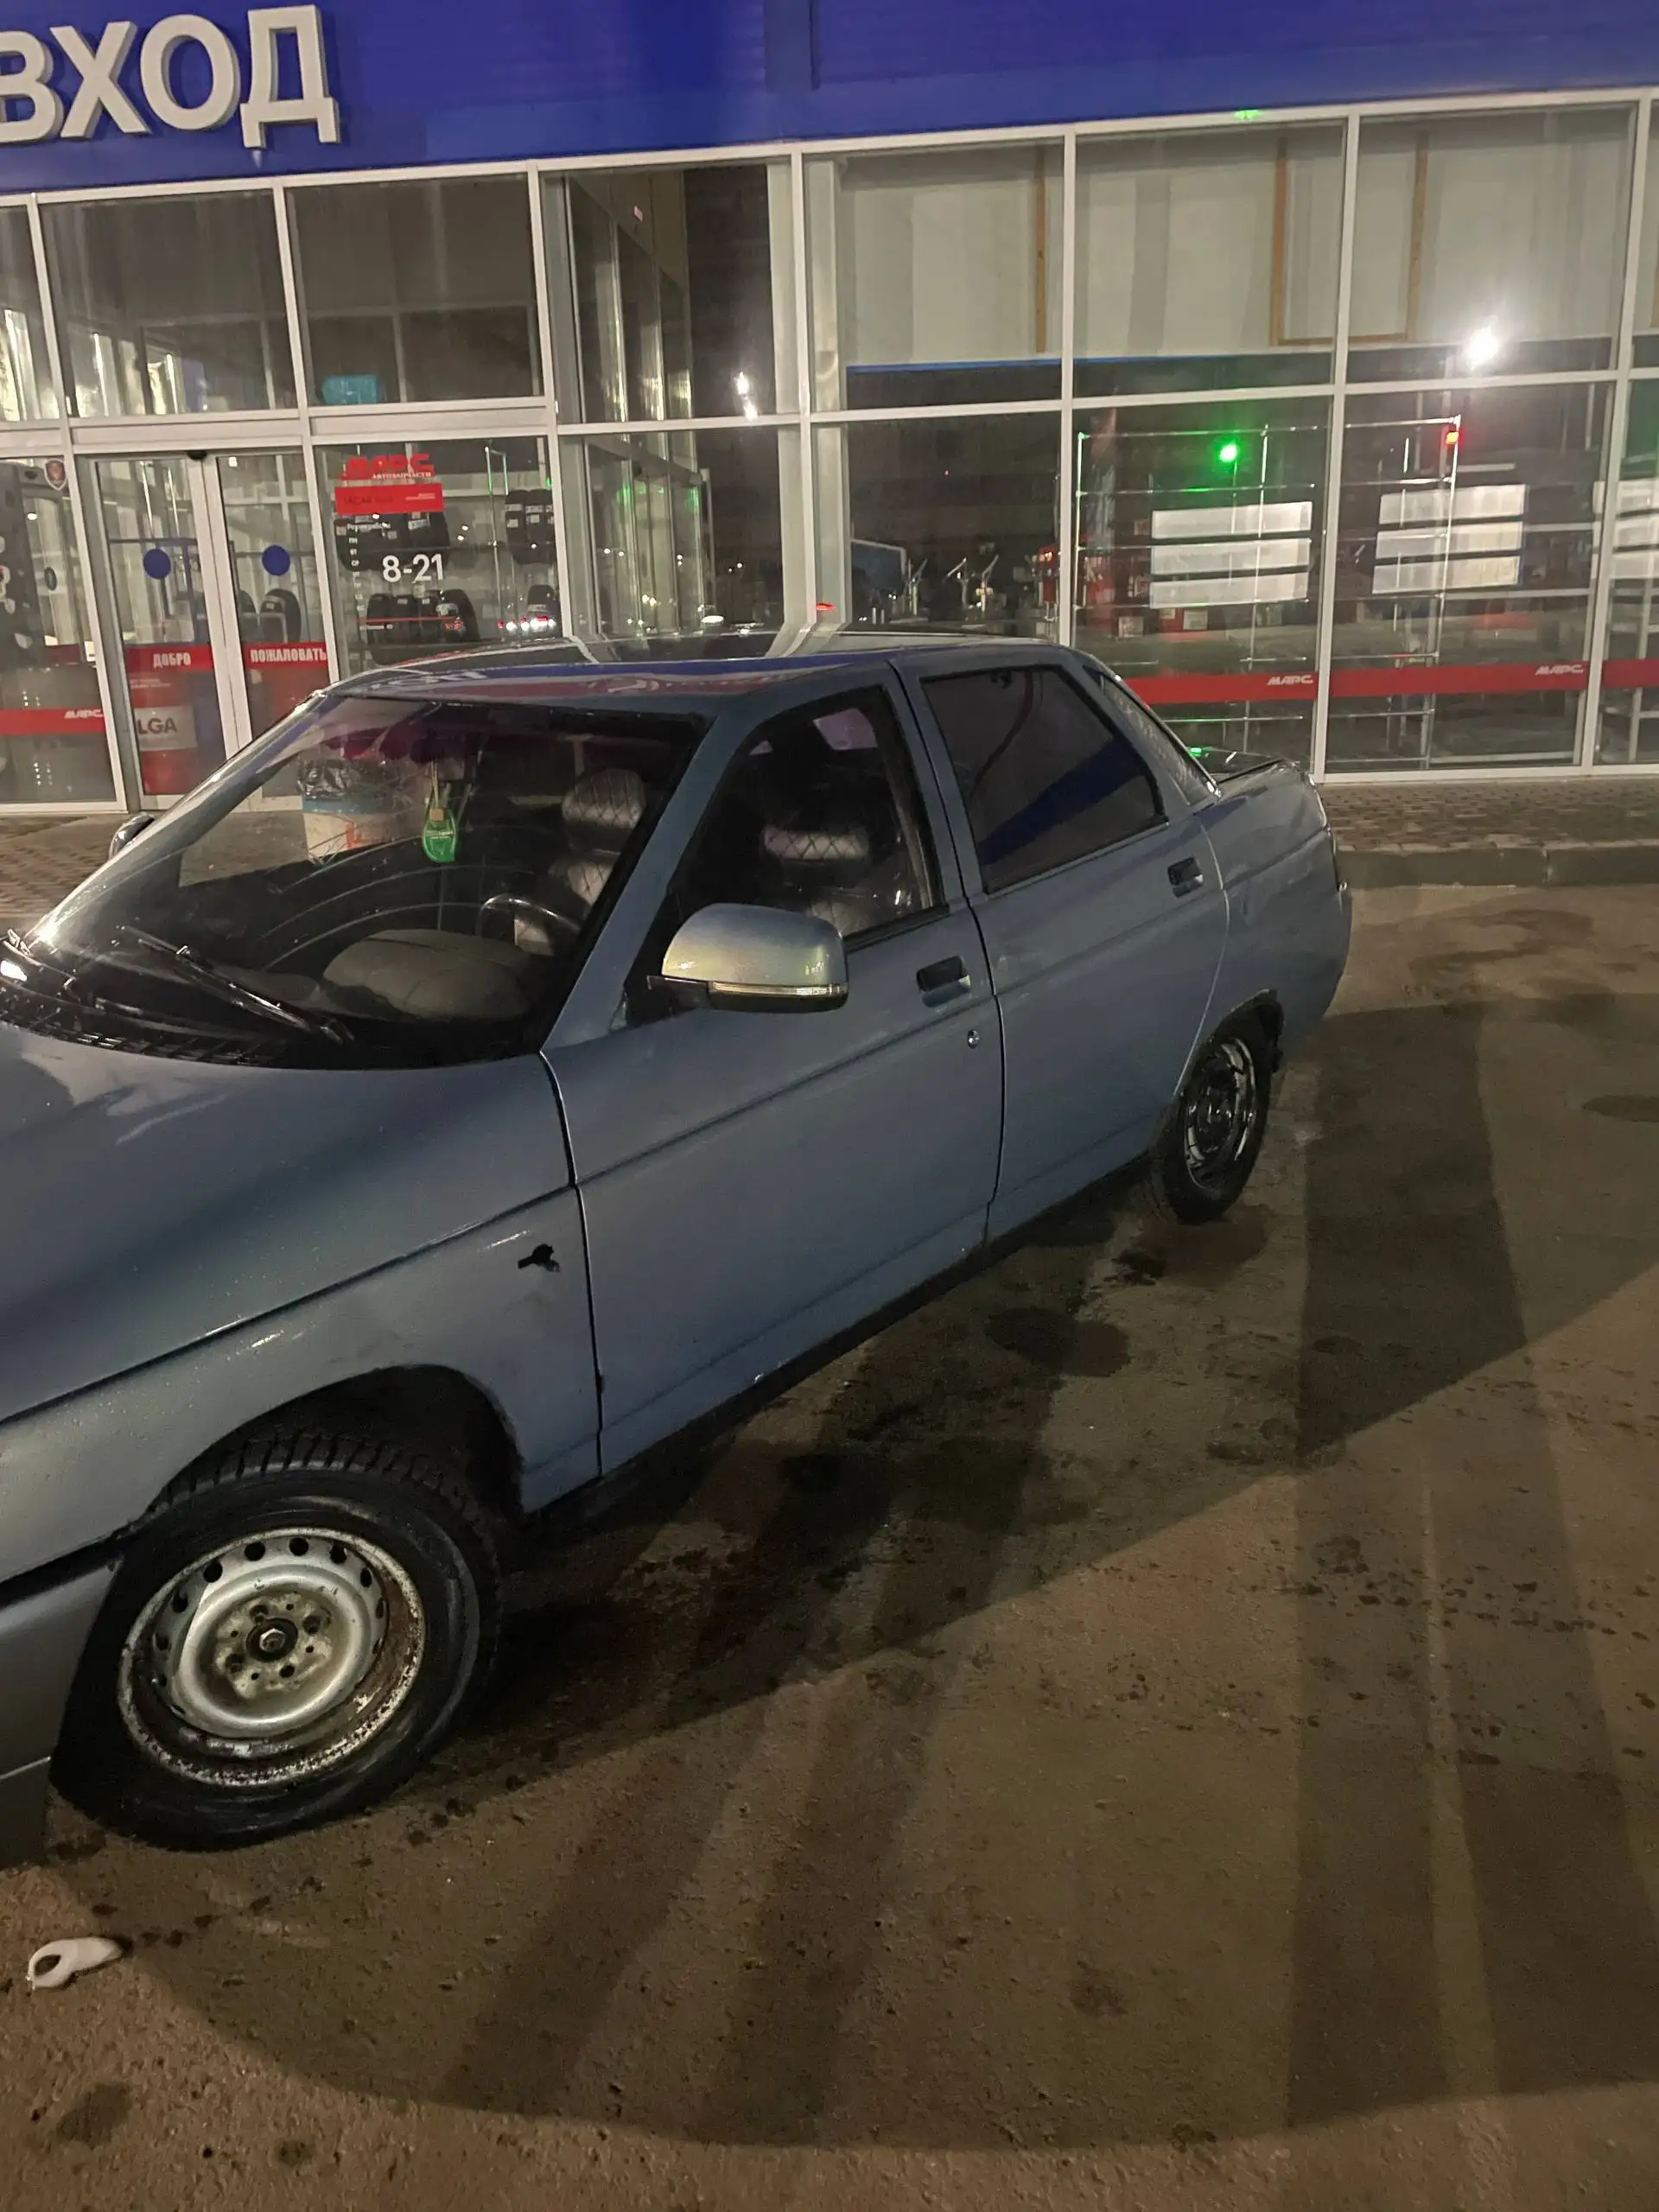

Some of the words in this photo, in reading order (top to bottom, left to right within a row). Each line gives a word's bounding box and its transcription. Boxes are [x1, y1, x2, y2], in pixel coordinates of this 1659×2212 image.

[0, 4, 340, 149] ВХОД
[382, 553, 444, 584] 8-21
[152, 652, 192, 669] ДОБРО
[250, 647, 327, 663] ПОЖАЛОВАТЬ
